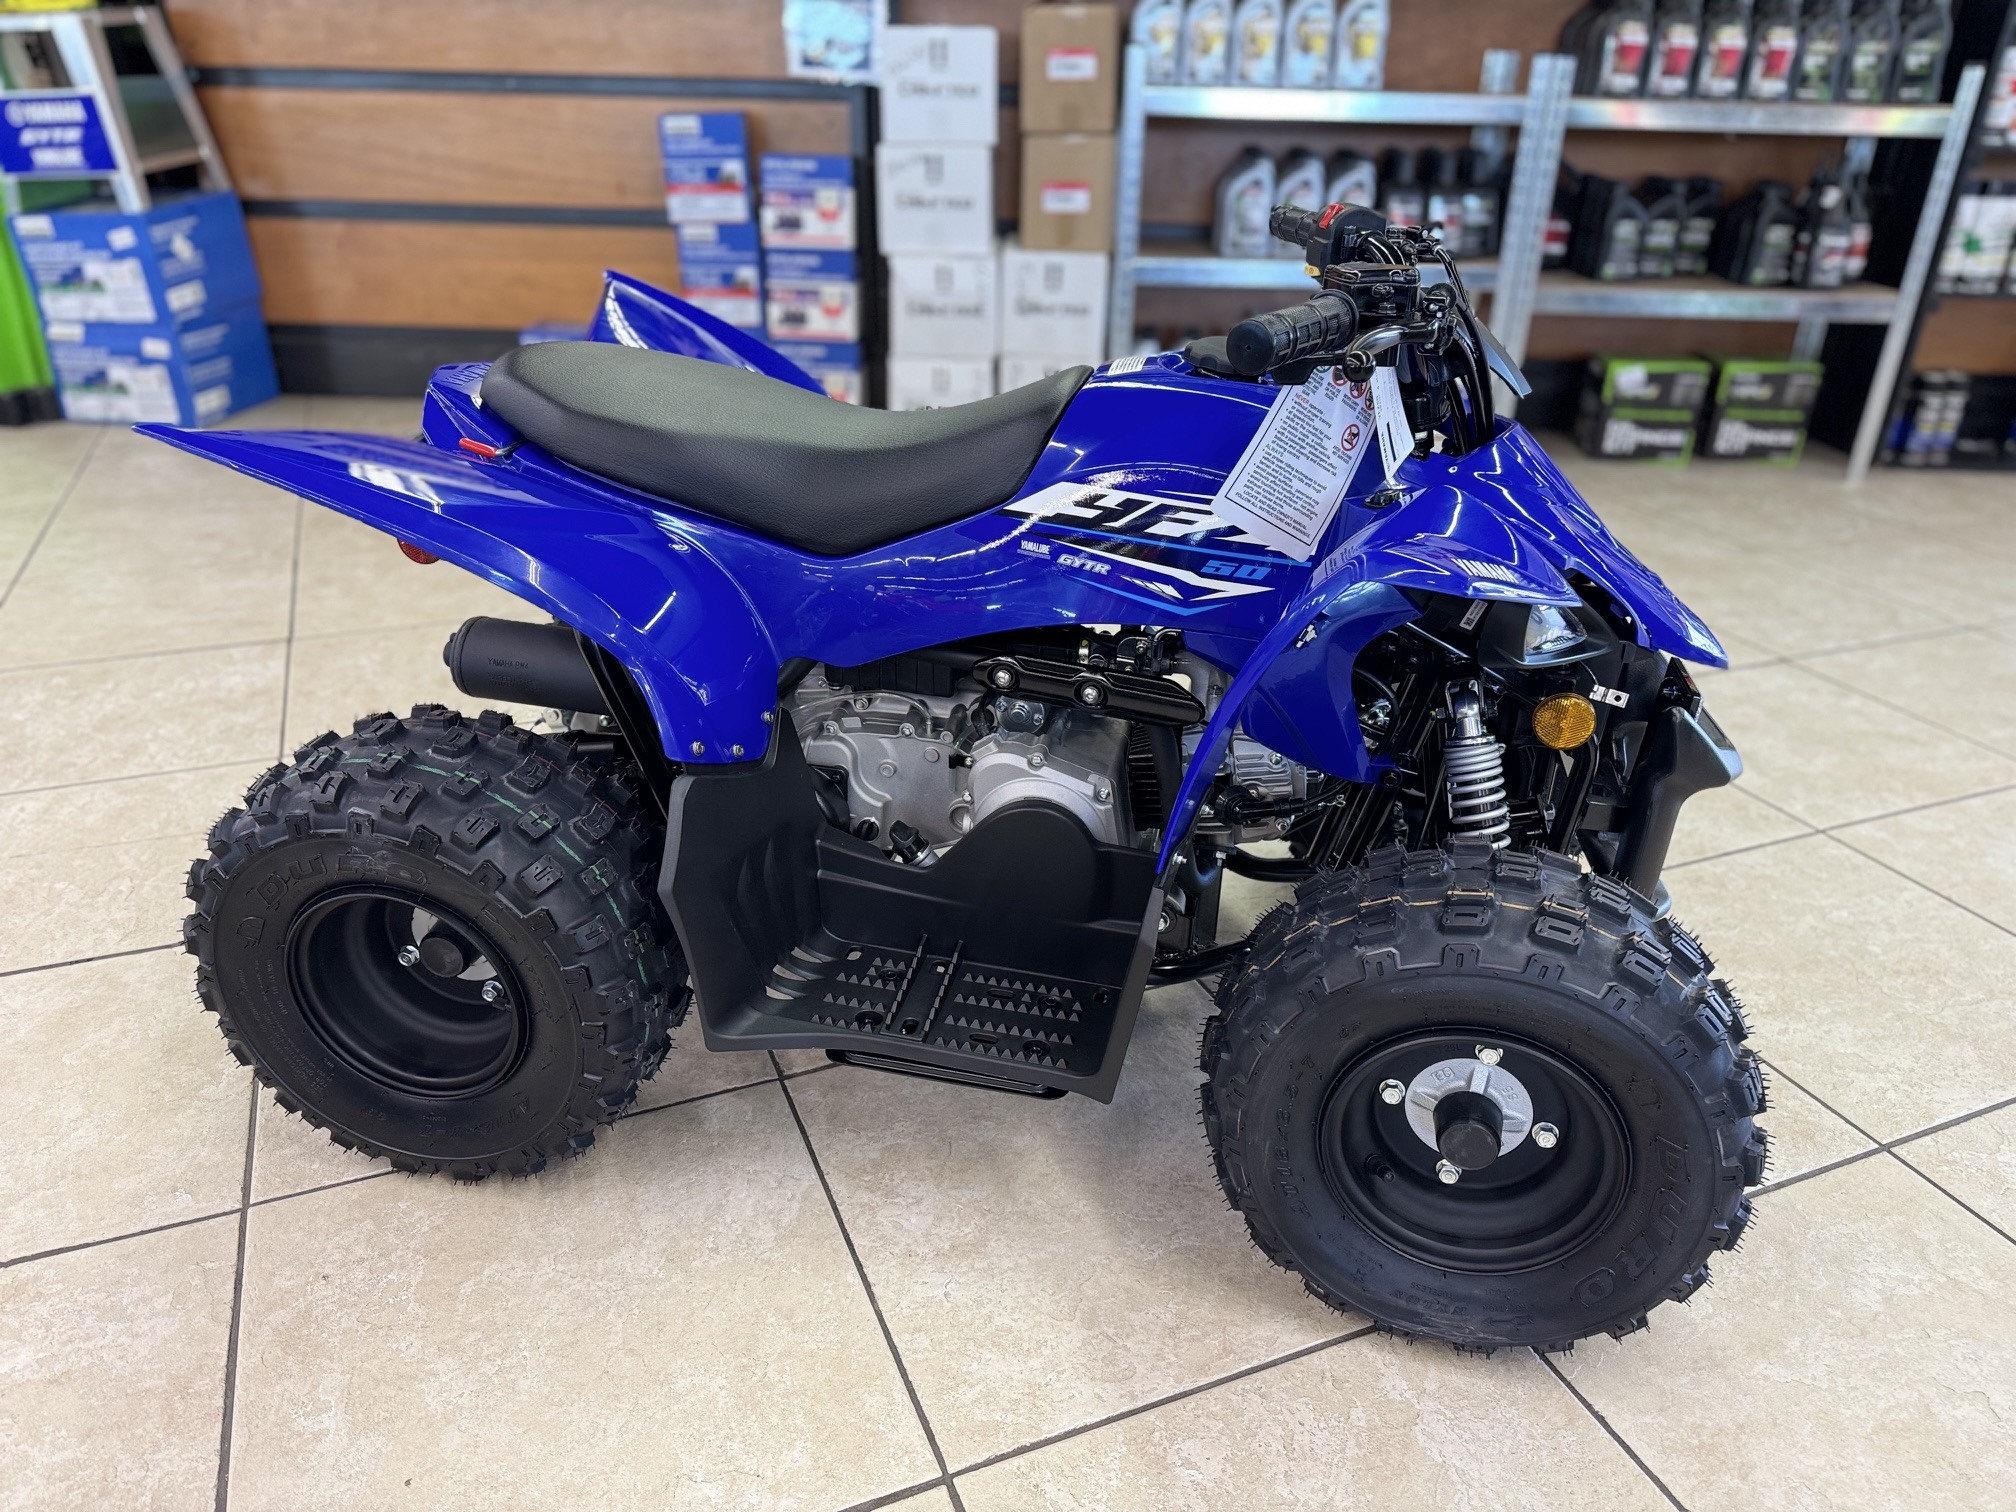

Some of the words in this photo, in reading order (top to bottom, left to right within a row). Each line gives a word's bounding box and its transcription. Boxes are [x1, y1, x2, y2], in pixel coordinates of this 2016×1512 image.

[1294, 392, 1309, 405] NEVER
[1285, 414, 1295, 423] skills
[1293, 399, 1308, 411] without
[1306, 408, 1319, 420] proper
[1318, 416, 1331, 428] training
[1287, 422, 1299, 433] public
[1298, 430, 1309, 439] roads
[1292, 412, 1306, 424] speeds
[1323, 433, 1331, 441] your
[1273, 433, 1289, 446] balance
[1295, 447, 1310, 460] steering
[1309, 456, 1317, 464] and
[1316, 461, 1330, 472] increase
[1275, 441, 1287, 452] losing
[1276, 429, 1285, 437] with
[1287, 436, 1306, 451] passenger
[1308, 449, 1327, 465] passengers
[1327, 461, 1337, 470] affect
[1287, 429, 1297, 438] occur
[1297, 435, 1306, 443] with
[1305, 440, 1319, 452] another
[1258, 458, 1272, 469] terrain
[1271, 466, 1279, 474] and
[1261, 454, 1275, 465] vehicle
[1274, 462, 1292, 476] overturns
[1310, 485, 1321, 494] rough
[1271, 454, 1283, 465] proper
[1283, 461, 1294, 471] riding
[1294, 468, 1313, 483] techniques
[1317, 482, 1326, 490] avoid
[1243, 482, 1254, 492] parts
[1261, 493, 1273, 502] cause
[1249, 473, 1261, 482] avoid
[1259, 479, 1277, 492] touching
[1282, 493, 1298, 505] surfaces
[1252, 468, 1270, 482] seriously
[1269, 478, 1281, 488] affect
[1280, 485, 1296, 497] handling
[1255, 463, 1266, 473] avoid
[1265, 470, 1278, 480] paved
[1277, 477, 1293, 489] surfaces
[1294, 487, 1312, 501] pavement
[1235, 491, 1251, 504] FOLLOW
[1250, 500, 1259, 508] ALL
[1258, 504, 1284, 523] INSTRUCTIONS
[1283, 519, 1292, 527] AND
[1242, 489, 1258, 501] LOCATE
[1266, 502, 1277, 511] READ
[1246, 477, 1262, 490] exhaust
[1261, 487, 1275, 498] system
[1282, 499, 1293, 508] those
[1292, 505, 1313, 521] surrounding
[1021, 540, 1051, 555] YAMALUBE
[1057, 553, 1112, 575] GYTR
[1201, 559, 1272, 581] 50
[1451, 557, 1519, 584] YAMAHA
[488, 657, 513, 668] YAMAHA
